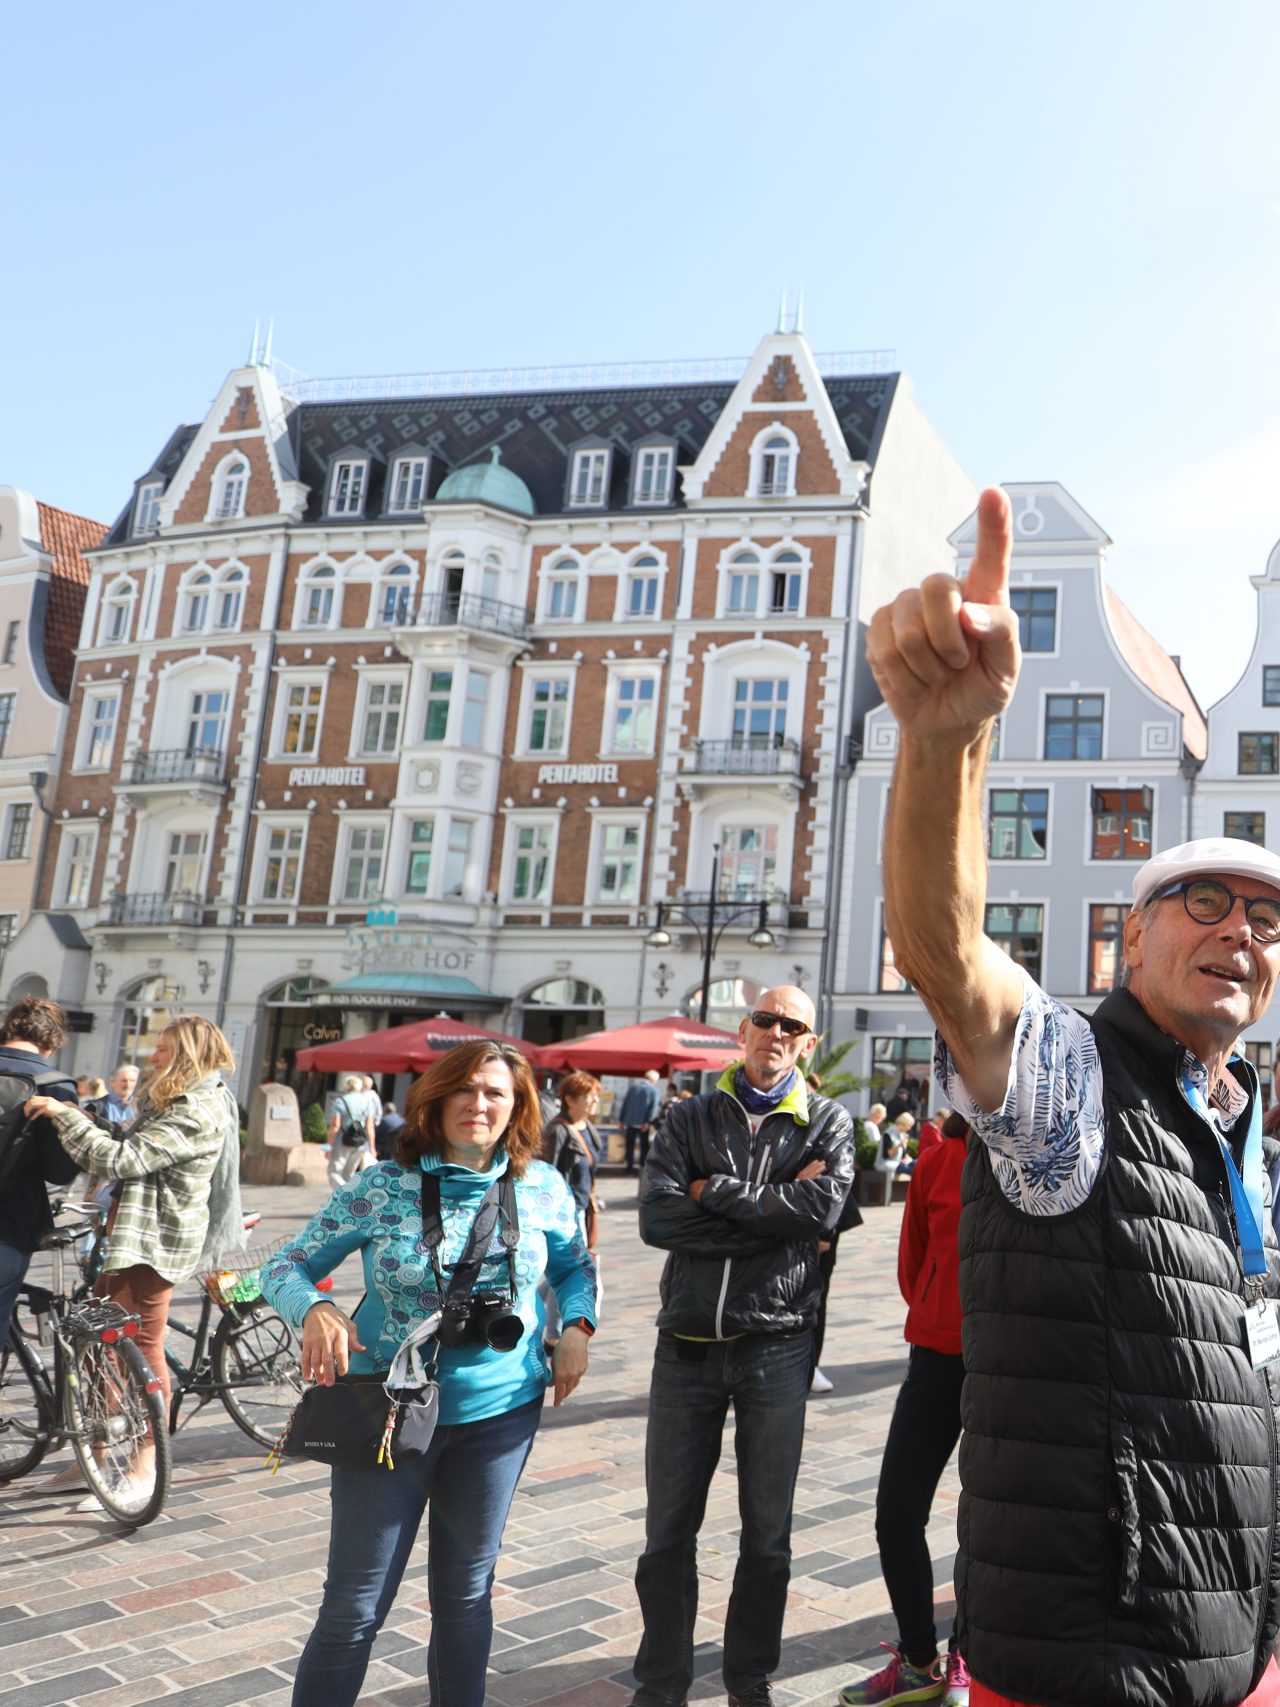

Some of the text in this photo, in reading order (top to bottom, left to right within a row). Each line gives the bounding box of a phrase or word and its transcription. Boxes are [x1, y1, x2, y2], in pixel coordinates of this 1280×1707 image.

[288, 767, 366, 786] PENTAHOTEL
[537, 763, 619, 784] PENTAHOTEL
[424, 951, 476, 970] HOF
